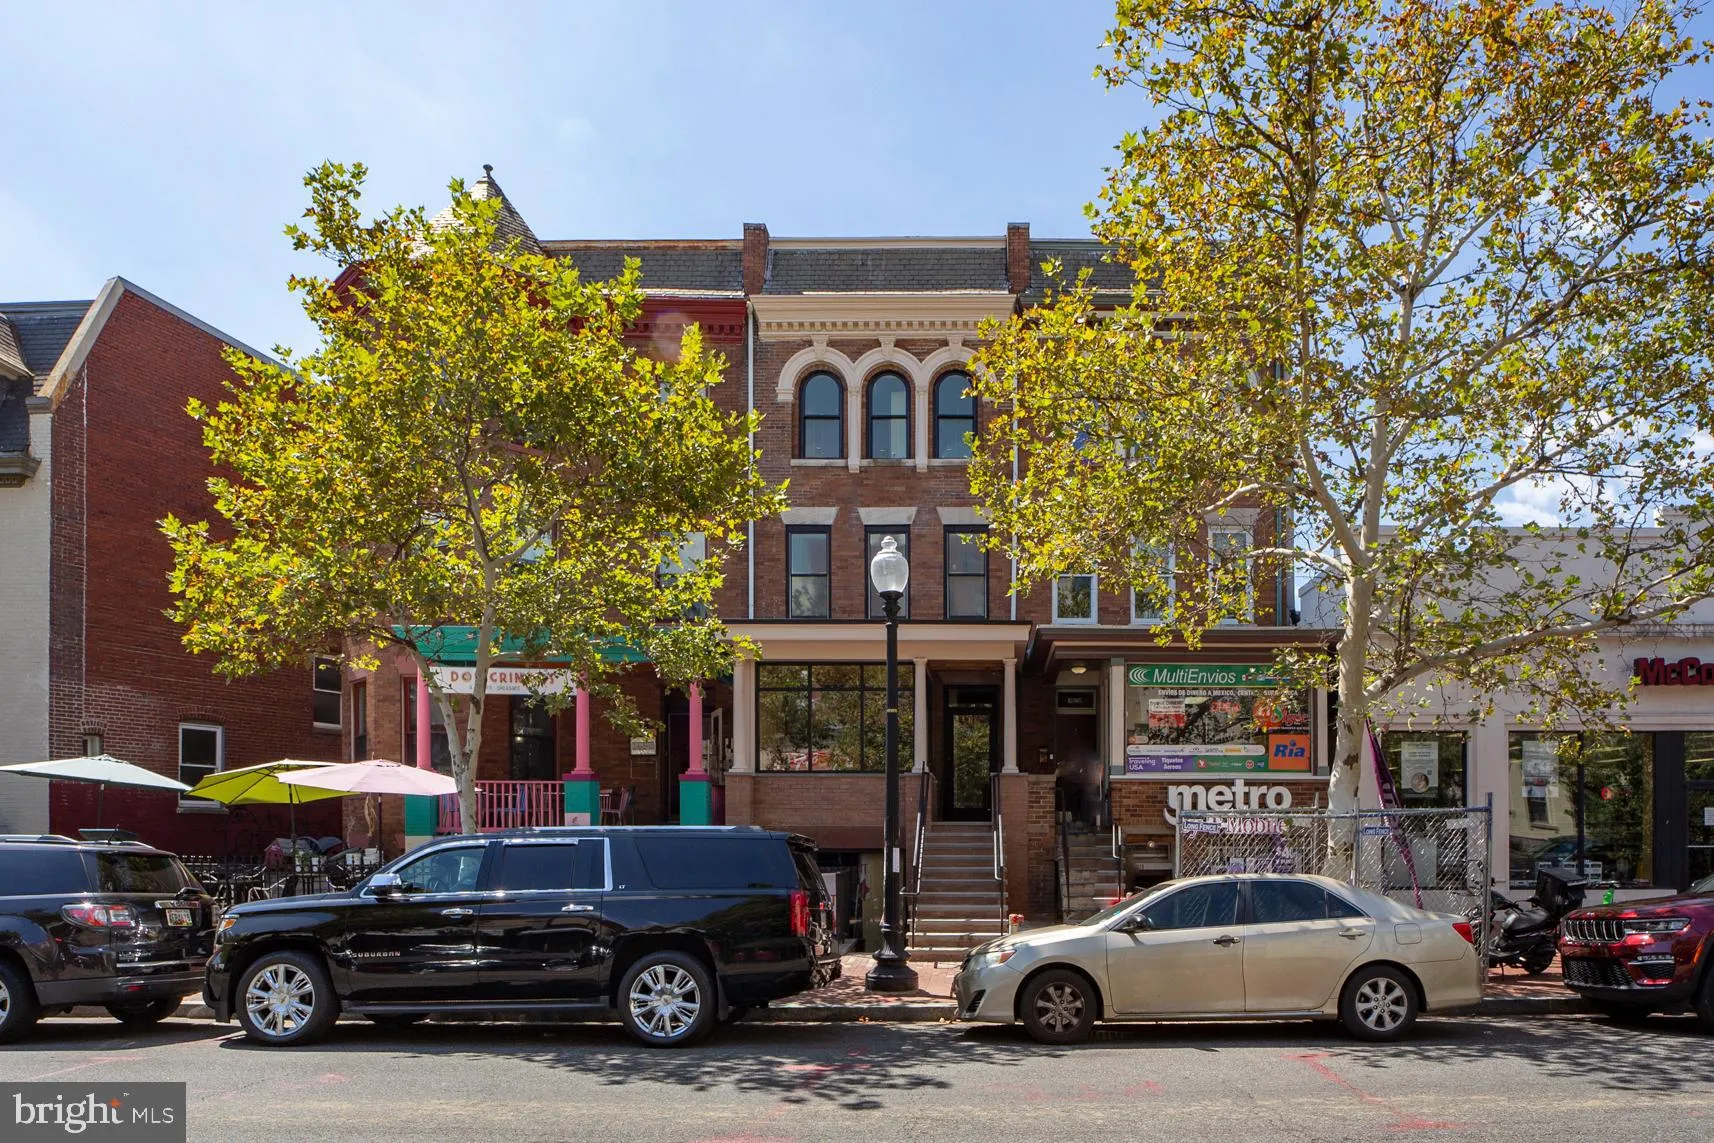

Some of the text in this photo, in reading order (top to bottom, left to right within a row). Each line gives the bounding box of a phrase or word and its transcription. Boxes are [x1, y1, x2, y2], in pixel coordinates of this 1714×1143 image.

[1153, 668, 1236, 684] MultiEnvios
[1274, 740, 1306, 758] Ria
[1128, 757, 1156, 765] Traveling
[1163, 779, 1292, 825] metro
[1184, 822, 1217, 831] LONG FENCE
